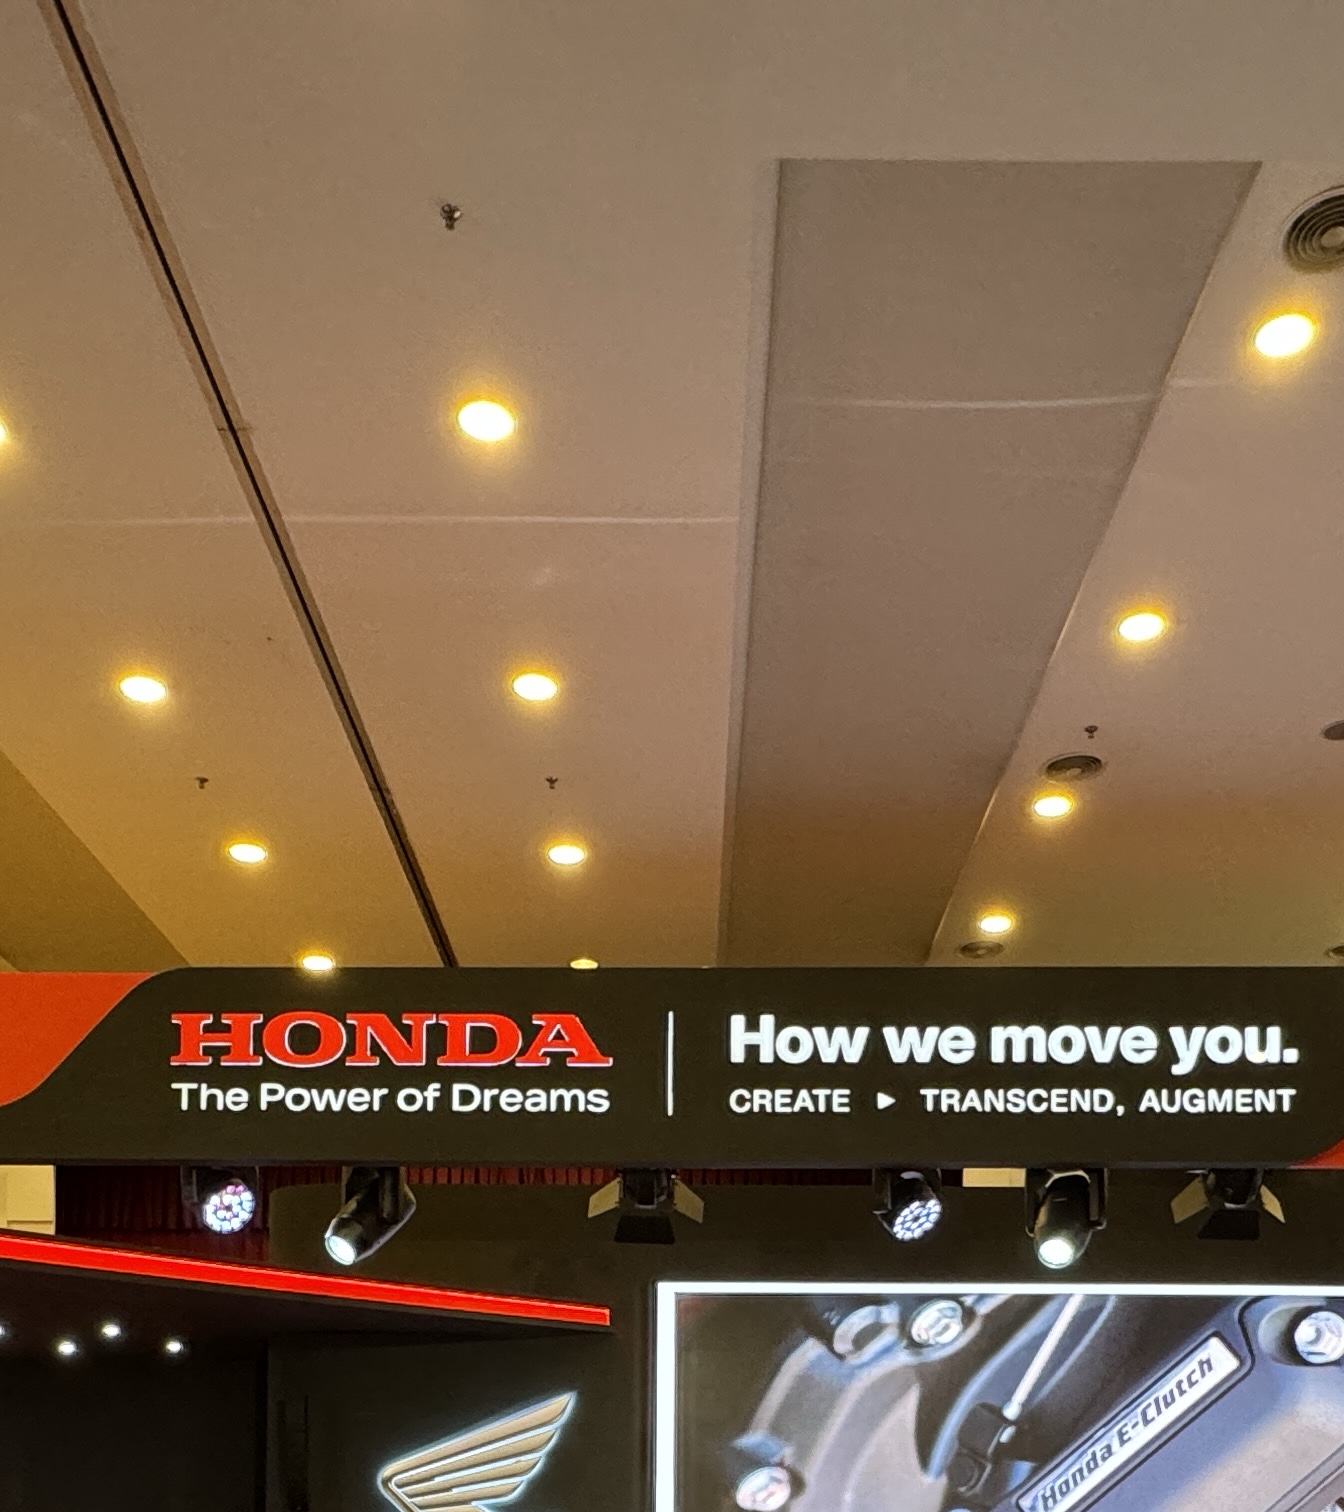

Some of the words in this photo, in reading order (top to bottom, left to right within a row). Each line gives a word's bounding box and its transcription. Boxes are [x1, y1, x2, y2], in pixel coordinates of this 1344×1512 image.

[170, 1010, 613, 1068] HONDA
[729, 1014, 870, 1065] How
[882, 1025, 976, 1065] we
[990, 1025, 1159, 1065] move
[1170, 1025, 1300, 1076] you.
[171, 1082, 250, 1112] The
[260, 1082, 389, 1113] Power
[397, 1082, 442, 1113] of
[452, 1082, 611, 1114] Dreams
[728, 1088, 852, 1115] CREATE
[920, 1088, 1125, 1118] TRANSCEND,
[1138, 1088, 1297, 1115] AUGMENT
[1116, 1355, 1214, 1448] E-Clutch
